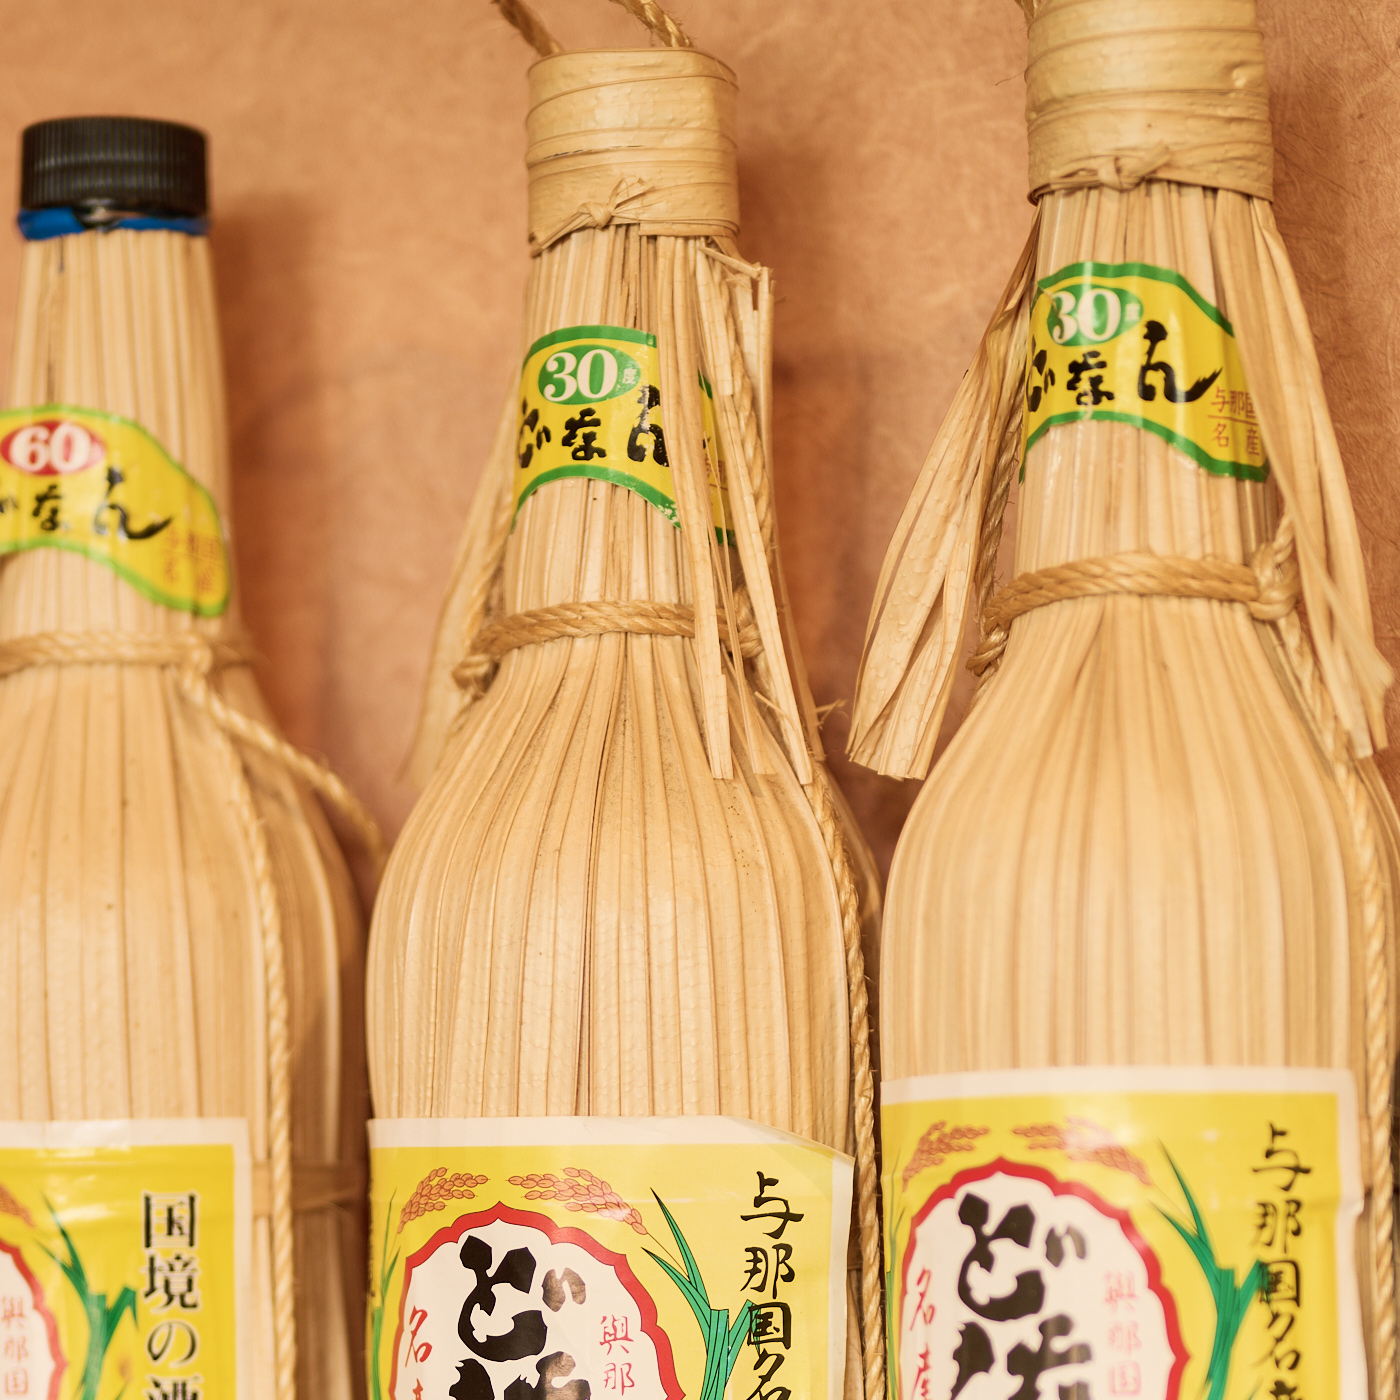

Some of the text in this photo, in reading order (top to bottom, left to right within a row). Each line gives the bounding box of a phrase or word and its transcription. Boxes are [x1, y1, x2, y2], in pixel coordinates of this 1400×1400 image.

[1052, 287, 1123, 345] 30
[543, 348, 638, 402] 30 度
[8, 420, 94, 474] 60
